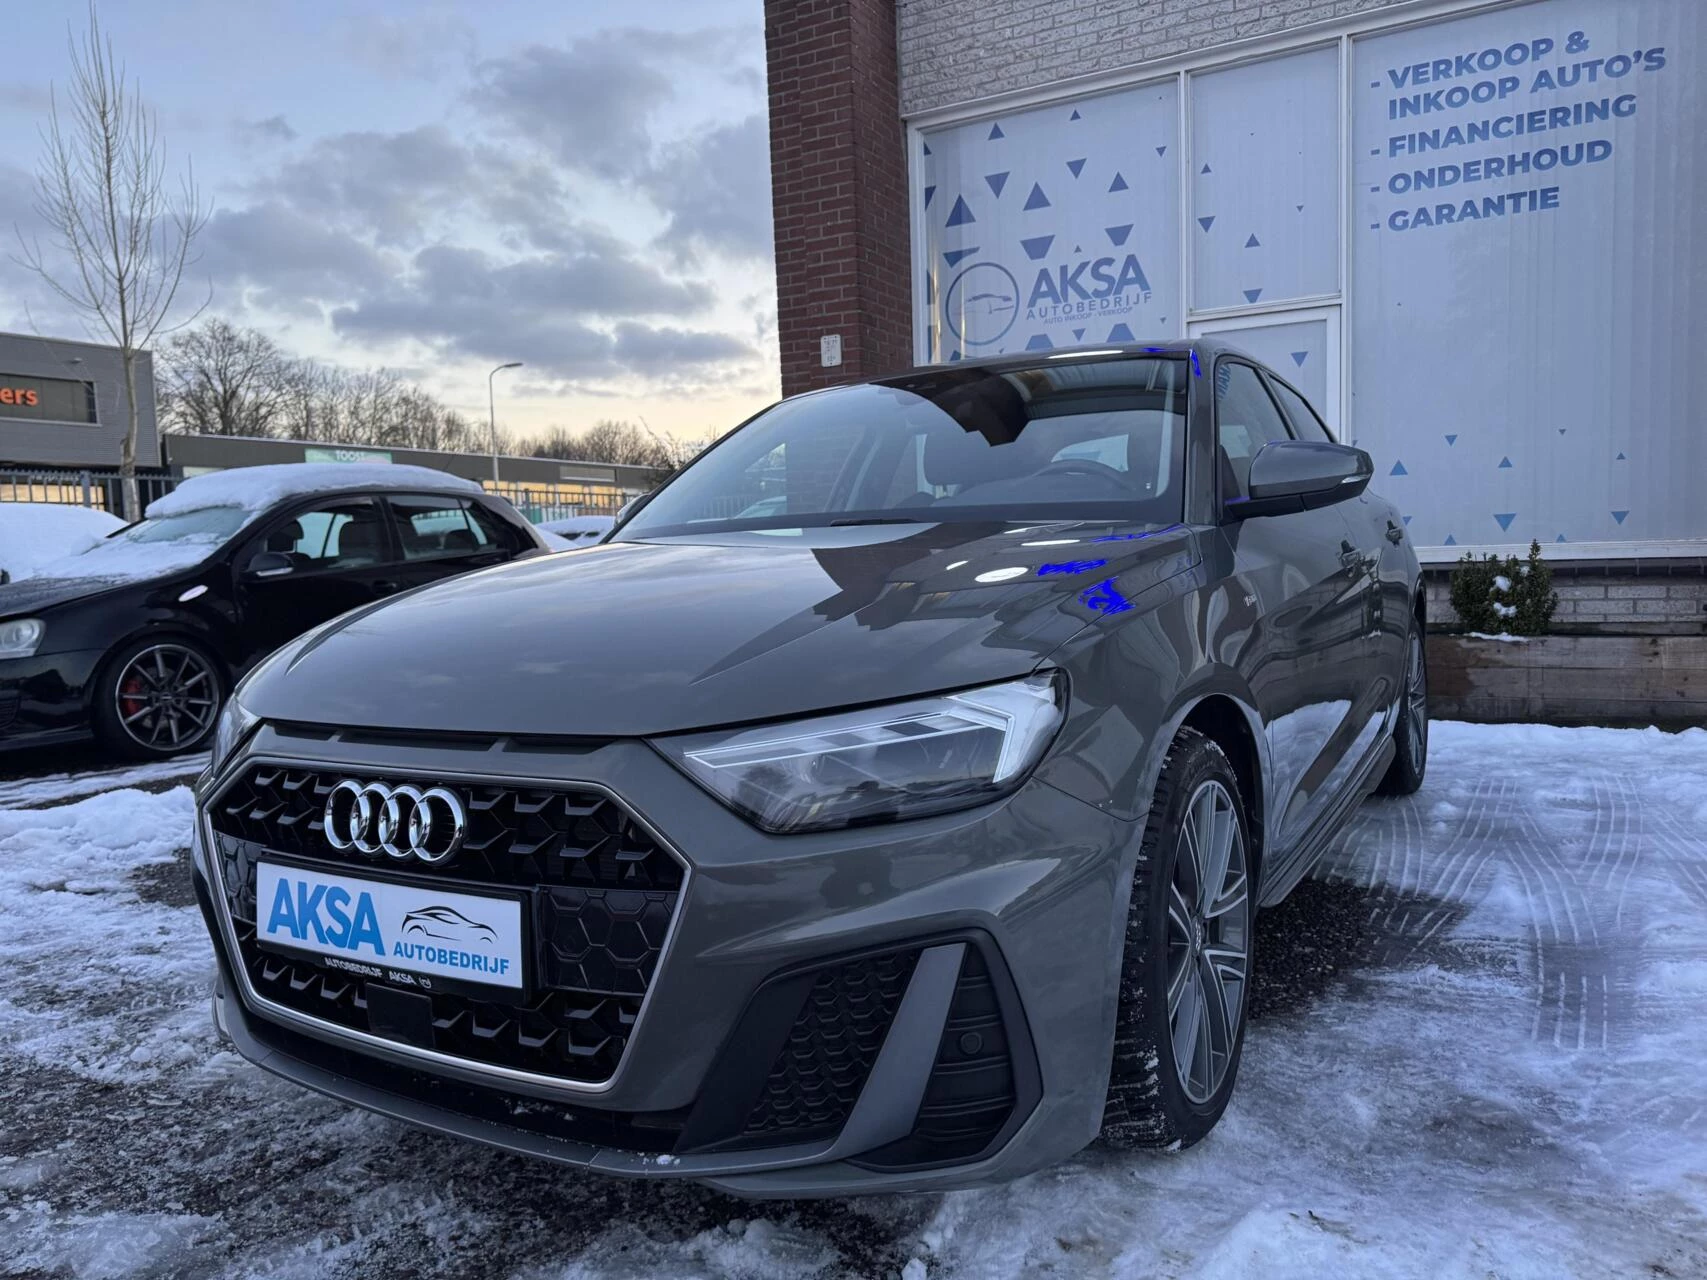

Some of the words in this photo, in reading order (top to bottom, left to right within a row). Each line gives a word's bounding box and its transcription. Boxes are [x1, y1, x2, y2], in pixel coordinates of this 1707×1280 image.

[1387, 38, 1554, 89] VERKOOP
[1565, 30, 1590, 54] &
[1389, 76, 1520, 120] INKOOP
[1389, 94, 1637, 157] FINANCIERING
[1388, 139, 1613, 194] ONDERHOUD
[1388, 186, 1560, 231] GARANTIE
[1027, 254, 1151, 308] AKSA
[1026, 291, 1152, 320] AUTOBEDRIJF
[0, 387, 39, 407] ers
[267, 878, 386, 956] AKSA
[324, 956, 383, 978] AUTOBEDRIJF
[388, 970, 417, 985] AKSA
[393, 941, 509, 975] AUTOBEDRIJF
